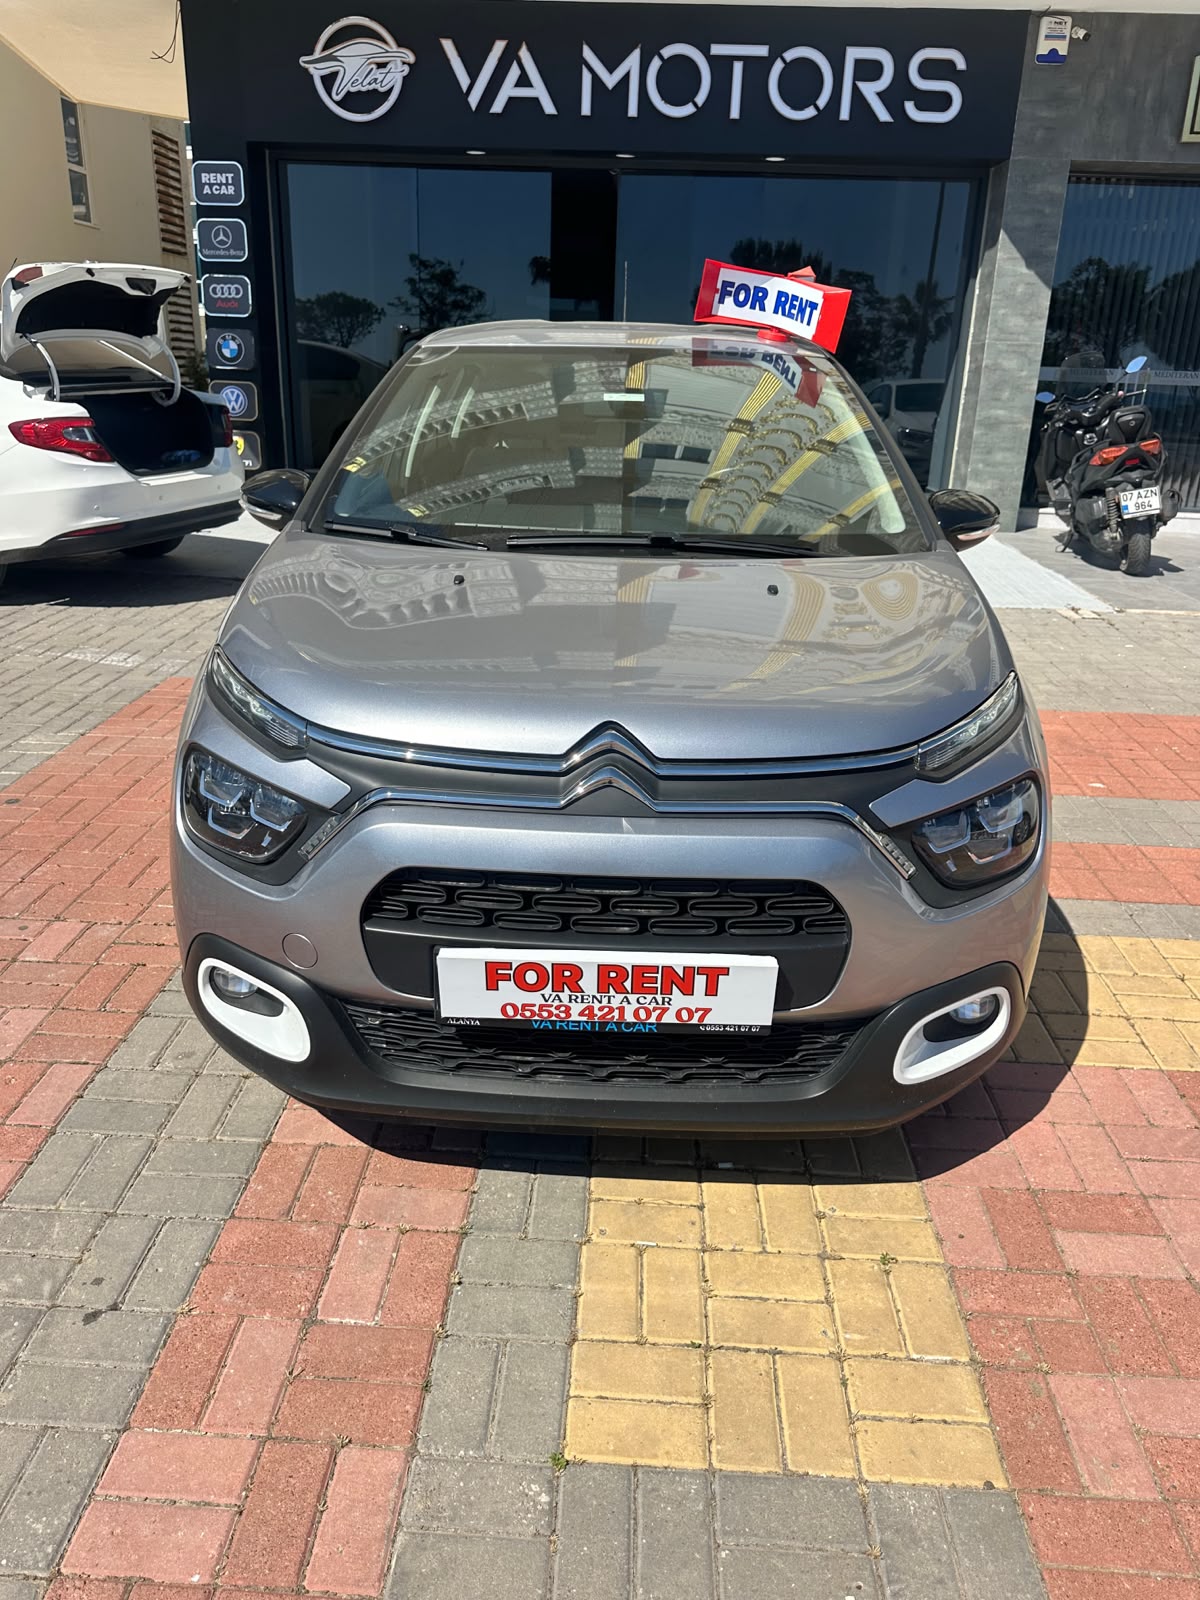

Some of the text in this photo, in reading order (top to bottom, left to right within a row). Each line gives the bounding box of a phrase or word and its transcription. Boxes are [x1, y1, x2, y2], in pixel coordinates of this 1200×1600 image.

[335, 57, 406, 96] Velat
[439, 37, 967, 123] VA MOTORS
[201, 173, 234, 184] RENT
[203, 185, 235, 195] A CAR
[202, 248, 245, 256] Mercedes-Benz
[216, 300, 239, 308] Audi
[717, 280, 819, 327] FOR RENT
[1122, 488, 1158, 502] 07 AZN
[1134, 501, 1153, 511] 964
[485, 961, 730, 997] FOR RENT
[540, 993, 673, 1006] VA RENT A CAR
[500, 1002, 713, 1024] 0553 421 07 07
[447, 1018, 481, 1026] ALANYA
[531, 1020, 552, 1030] VA
[605, 1022, 618, 1032] A
[621, 1022, 658, 1033] CAR
